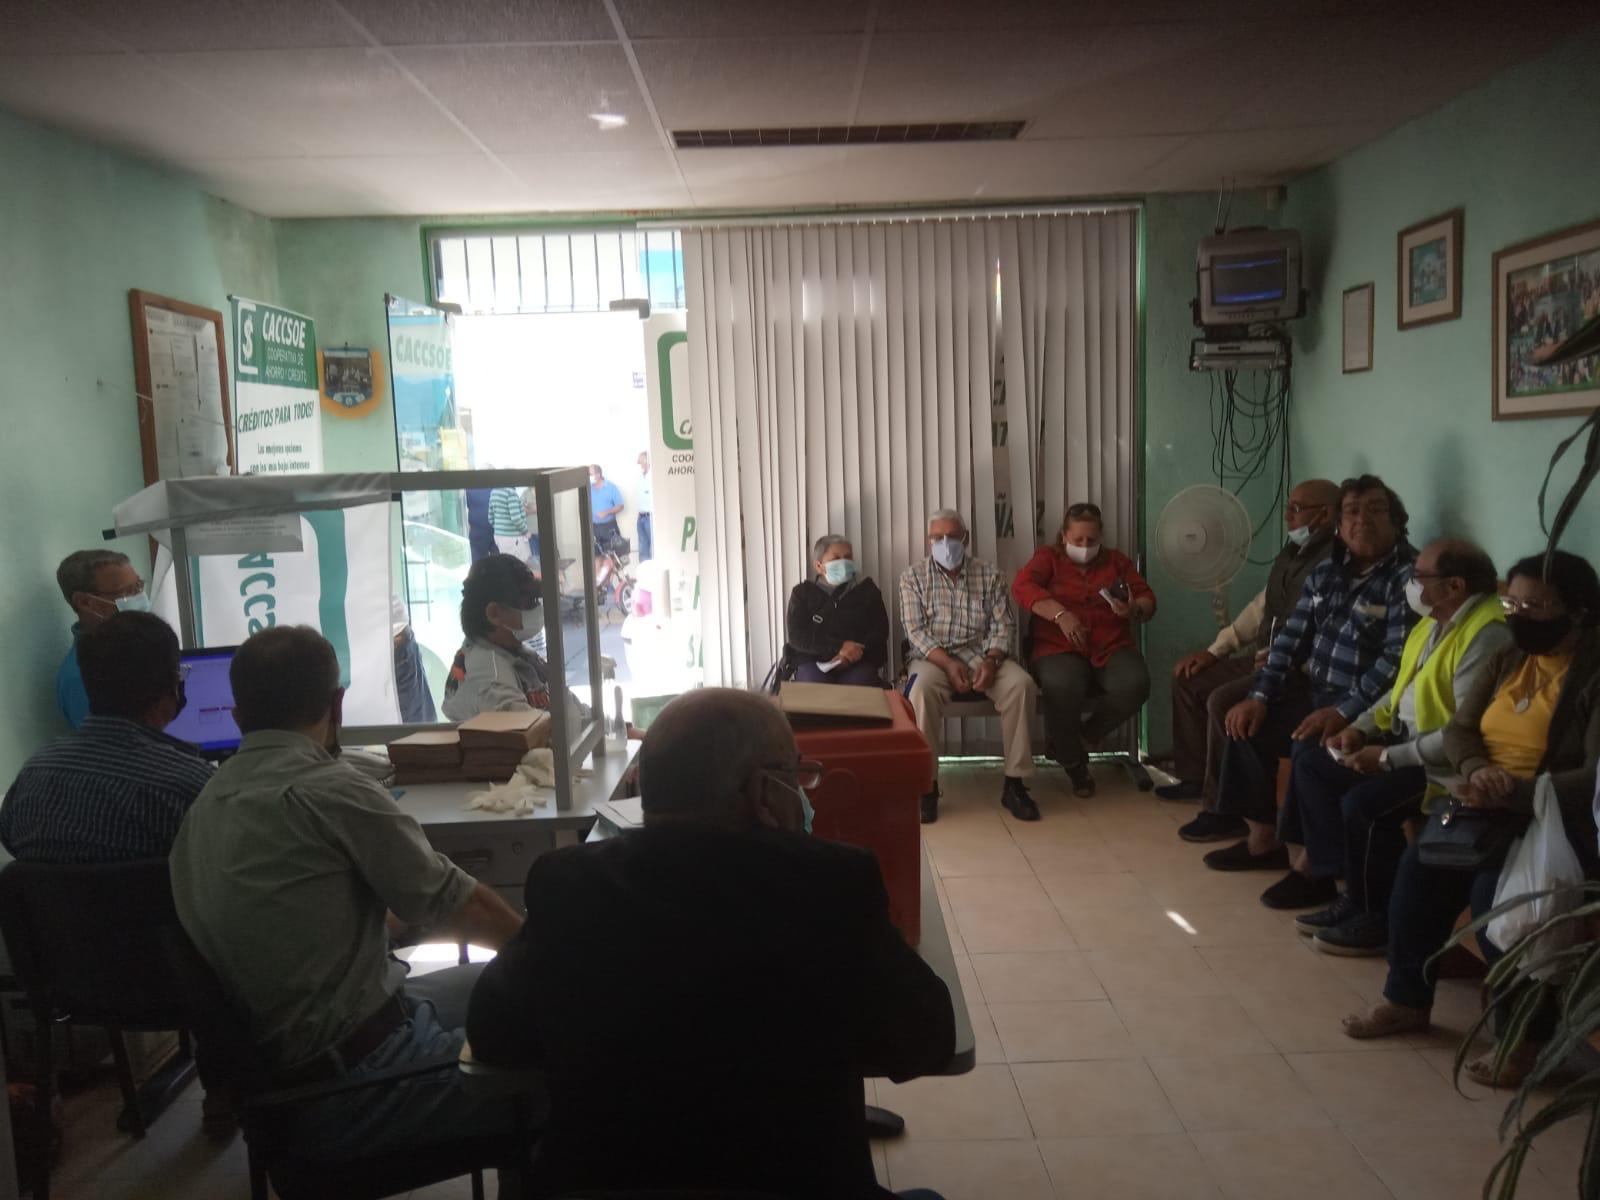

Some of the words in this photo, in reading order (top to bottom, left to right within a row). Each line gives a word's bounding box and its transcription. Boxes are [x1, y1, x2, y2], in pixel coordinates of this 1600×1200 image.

[262, 311, 306, 349] CACCSOE
[396, 335, 451, 370] CACCSOE
[238, 408, 274, 433] CRÉDITOS
[274, 404, 291, 424] PARA
[668, 466, 695, 476] AHOR
